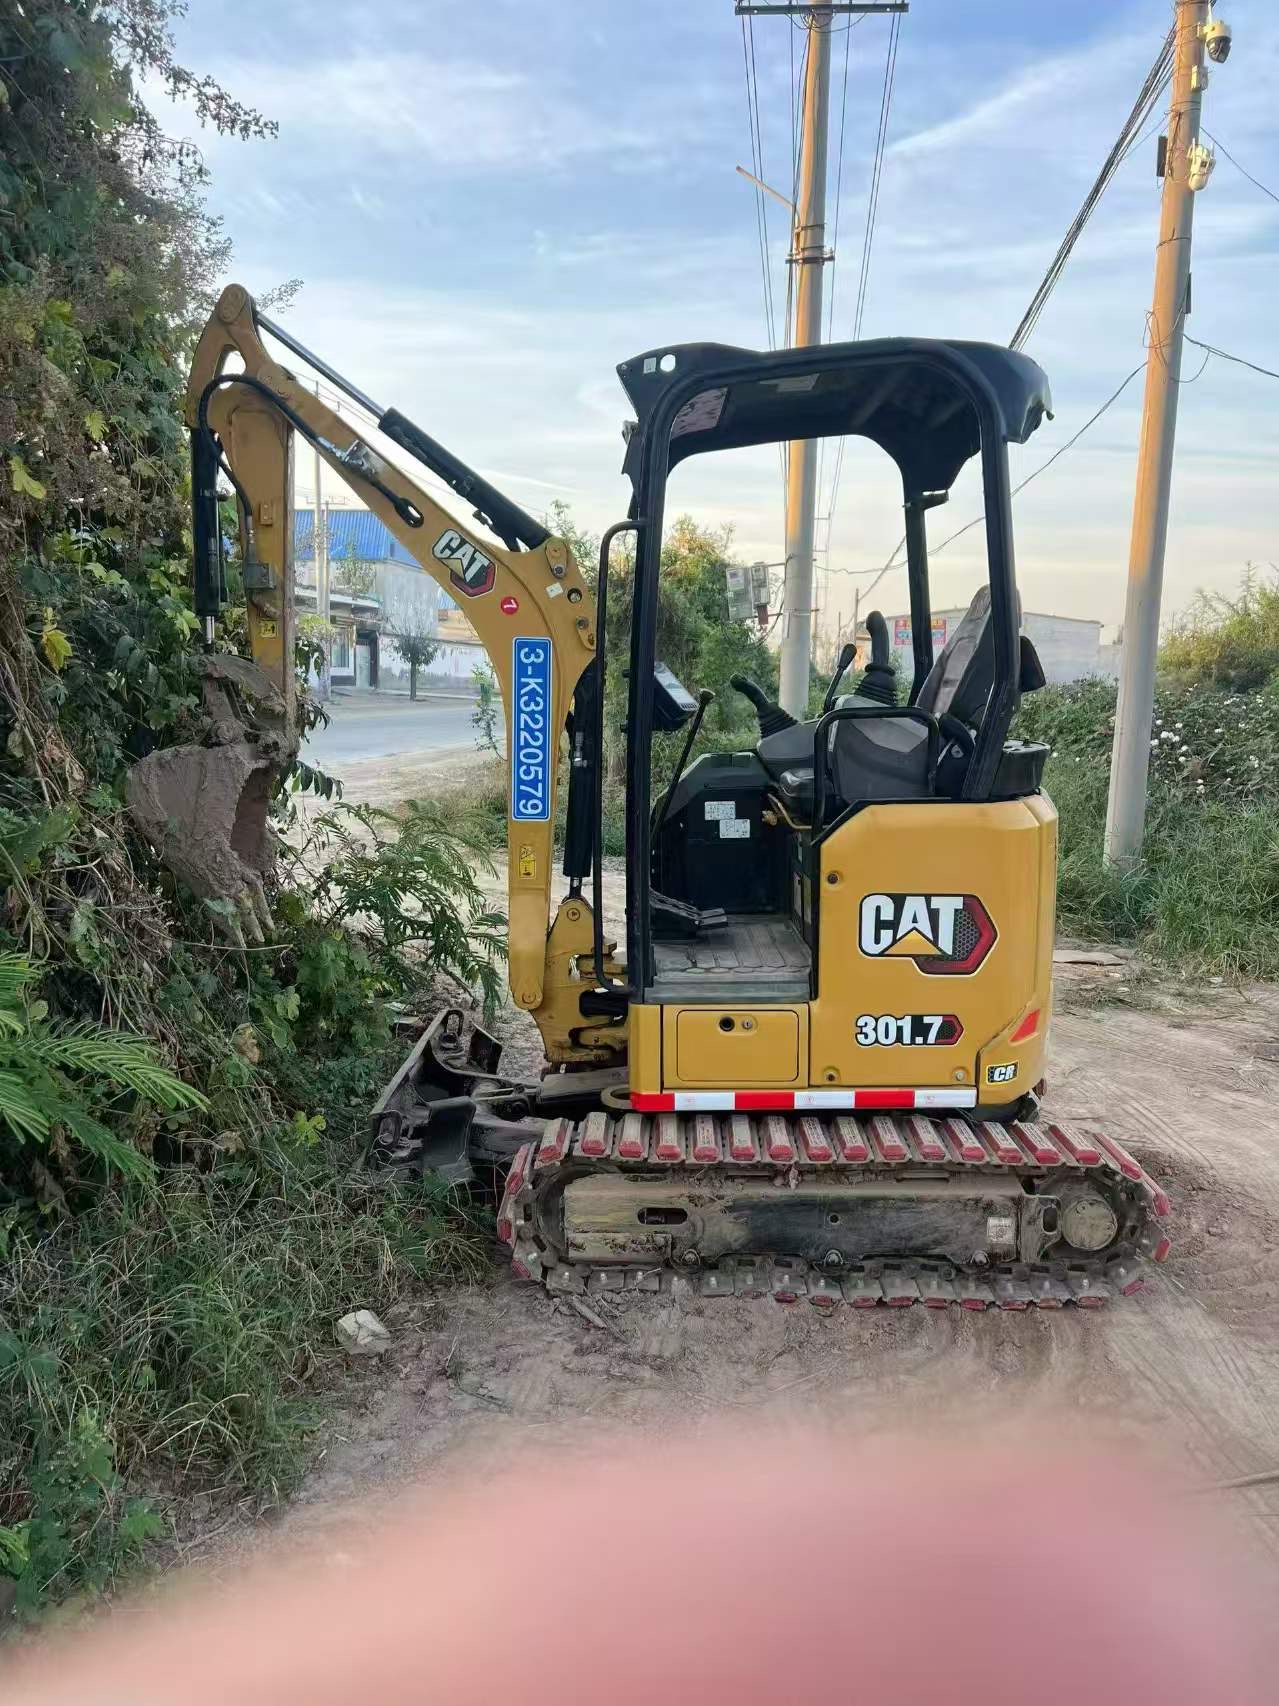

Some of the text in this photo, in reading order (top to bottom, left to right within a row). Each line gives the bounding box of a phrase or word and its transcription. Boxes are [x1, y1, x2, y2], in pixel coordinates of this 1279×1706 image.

[433, 528, 491, 583] CAT
[519, 647, 544, 816] 3-K3220579
[861, 894, 964, 956] CAT
[856, 1015, 944, 1045] 301.7
[993, 1065, 1015, 1082] CR
